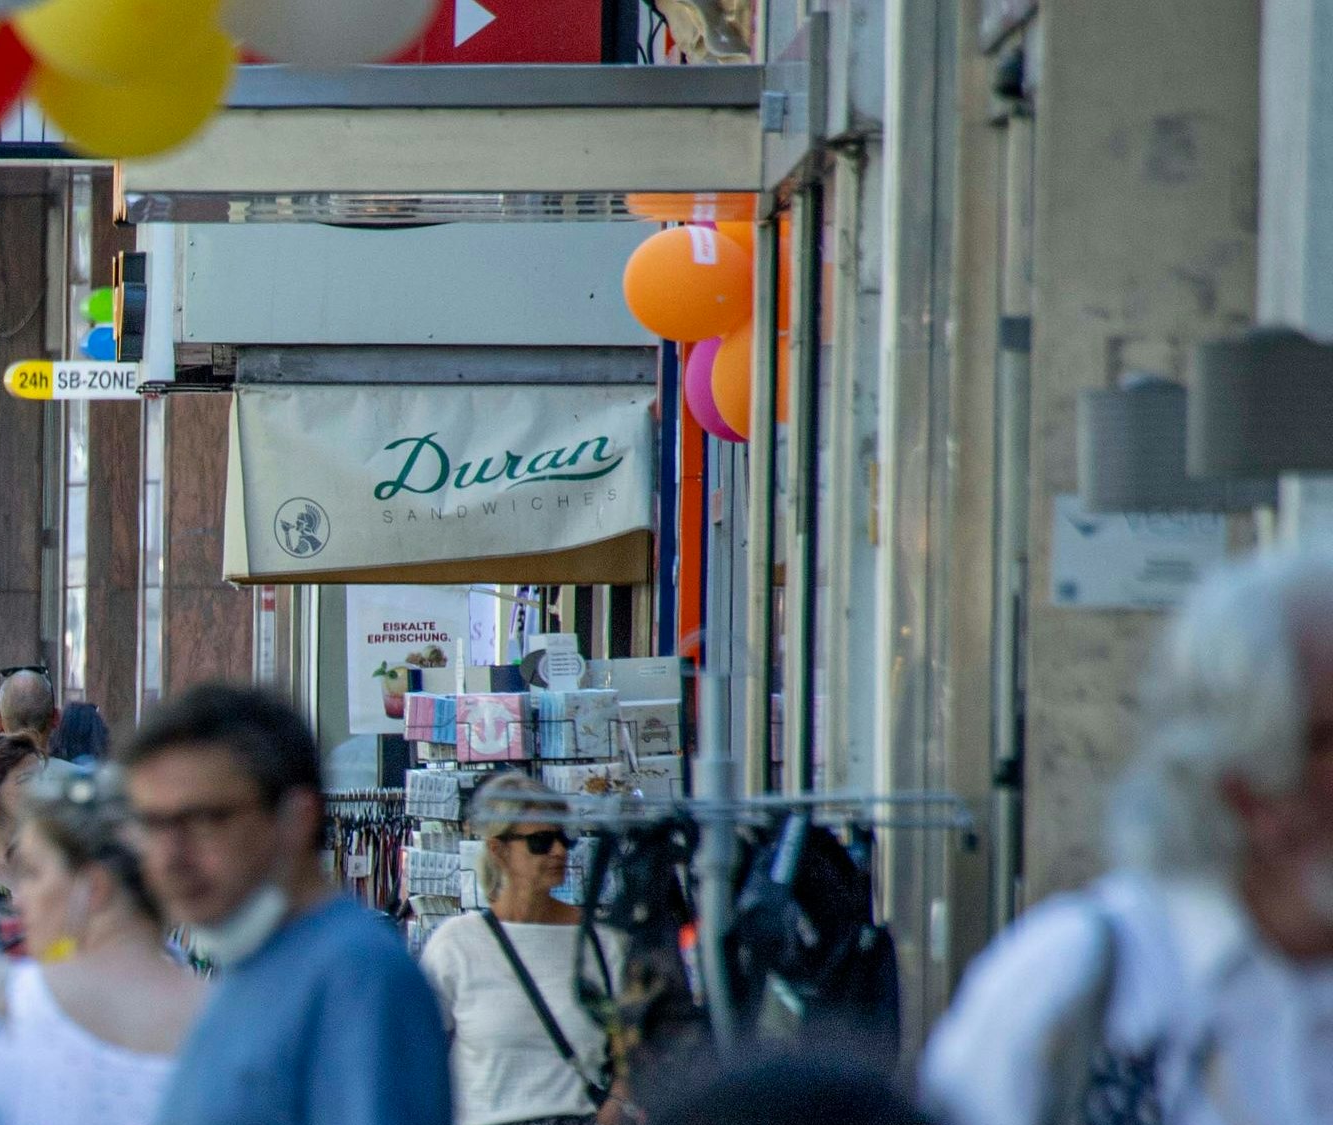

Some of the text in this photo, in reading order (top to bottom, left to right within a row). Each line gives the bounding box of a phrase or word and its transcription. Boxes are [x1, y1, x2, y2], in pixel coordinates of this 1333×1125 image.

[19, 371, 136, 389] 24h SB-ZONE
[374, 432, 623, 500] Duran
[383, 488, 617, 524] SANDWICHES
[383, 621, 436, 632] EISKALTE
[367, 633, 451, 644] ERFRISCHUNG.
